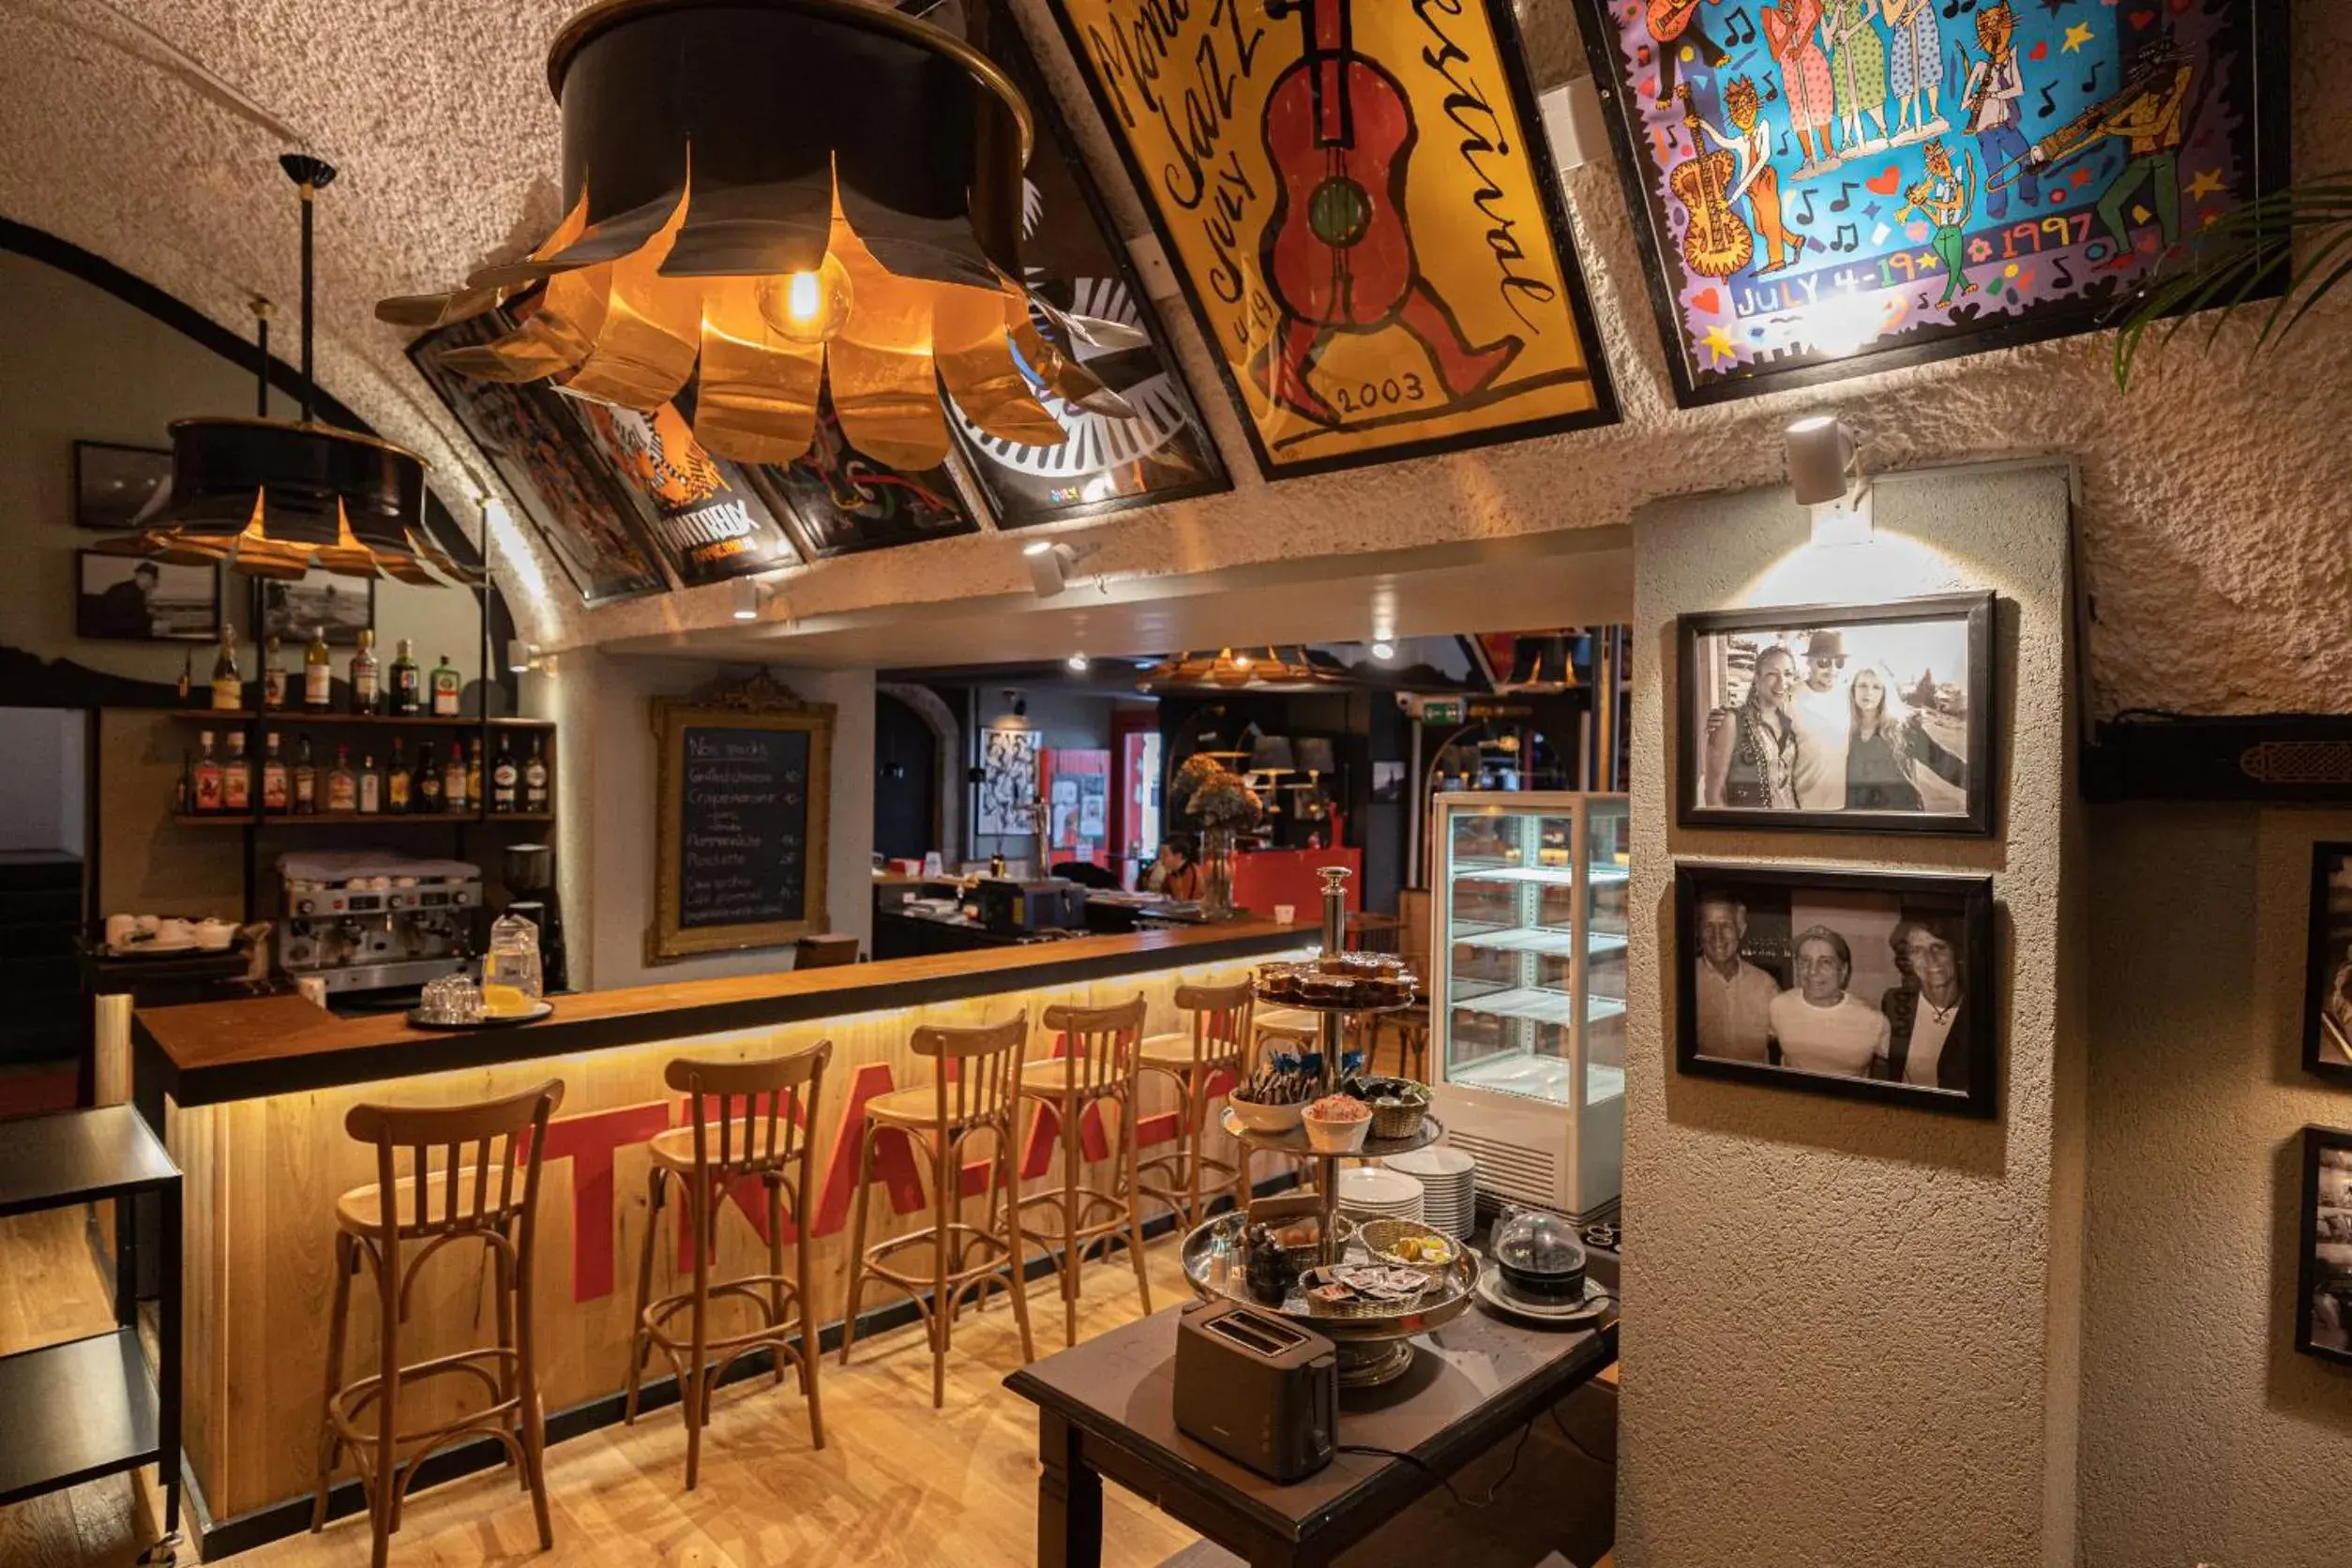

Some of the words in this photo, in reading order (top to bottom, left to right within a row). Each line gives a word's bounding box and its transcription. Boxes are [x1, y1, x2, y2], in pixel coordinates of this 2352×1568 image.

[1412, 0, 1557, 335] estival
[2001, 212, 2093, 260] 1997
[1737, 273, 1818, 316] JULY
[1337, 371, 1425, 414] 2003
